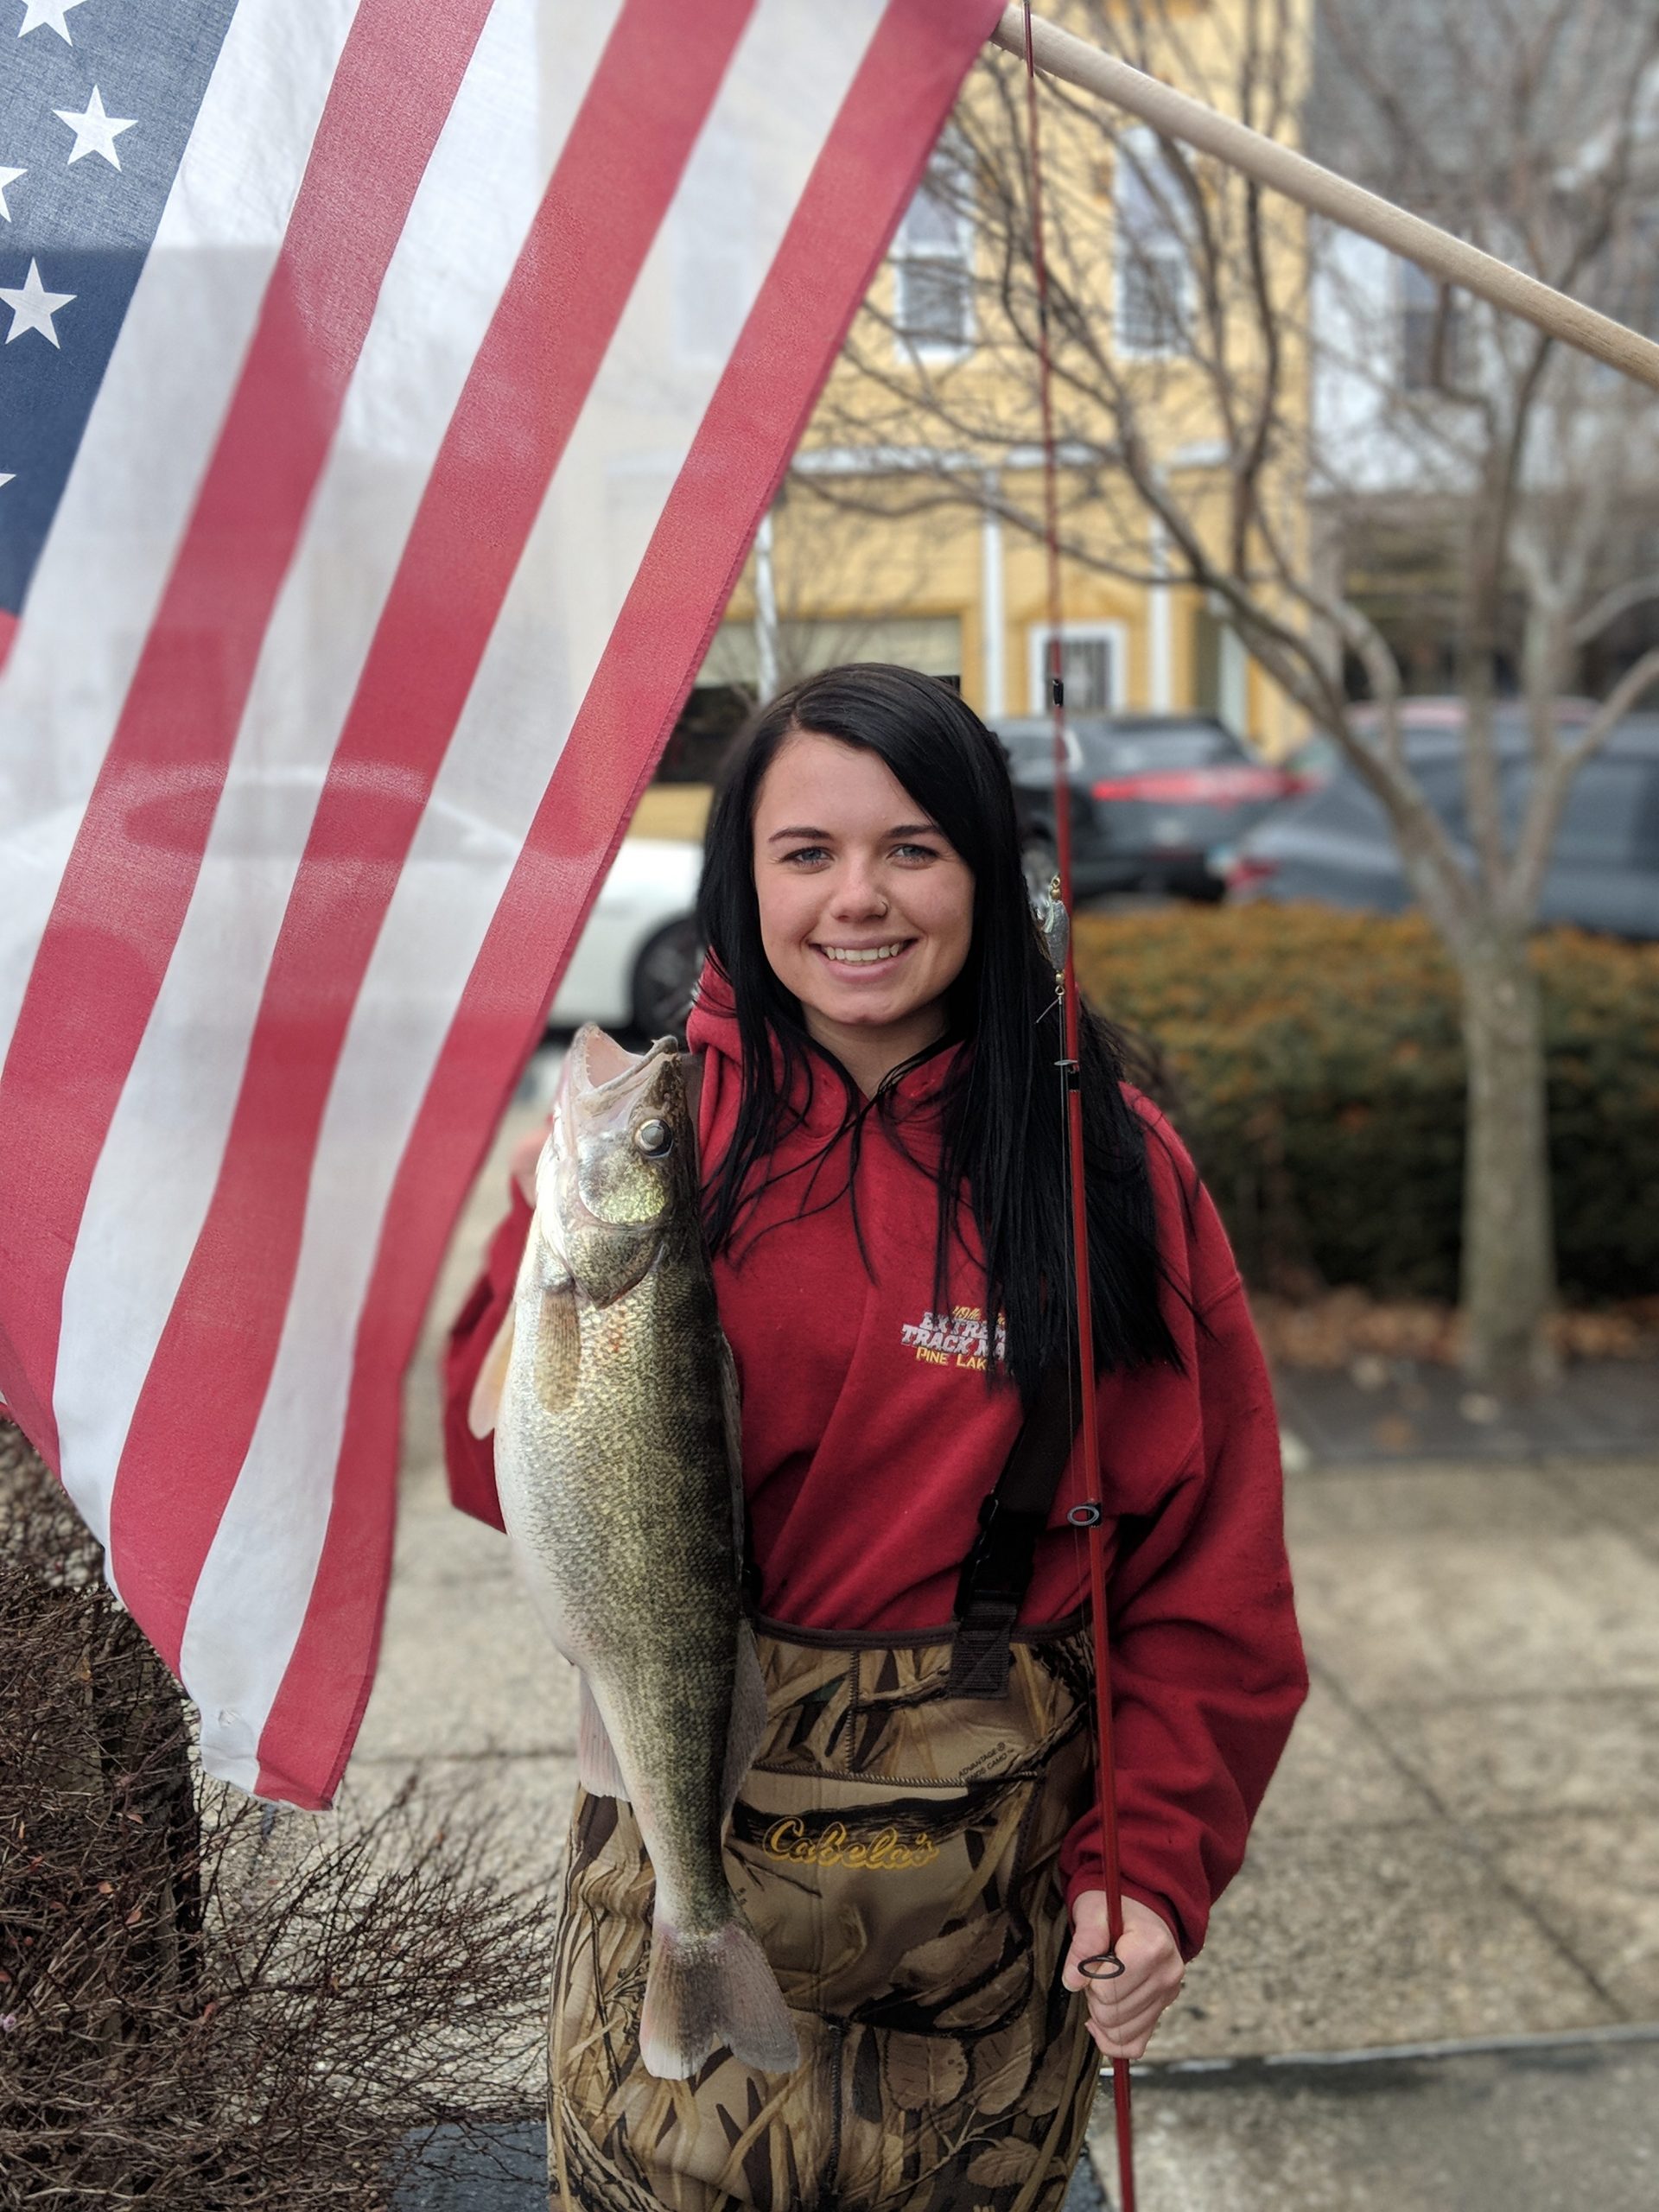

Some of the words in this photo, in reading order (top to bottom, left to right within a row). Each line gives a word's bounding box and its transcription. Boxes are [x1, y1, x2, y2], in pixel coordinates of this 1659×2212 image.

[901, 1324, 972, 1354] TRACK
[919, 1312, 1006, 1342] EXTREM
[917, 1346, 949, 1365] PINE
[957, 1354, 988, 1370] LAK
[761, 1815, 941, 1871] Cabela's
